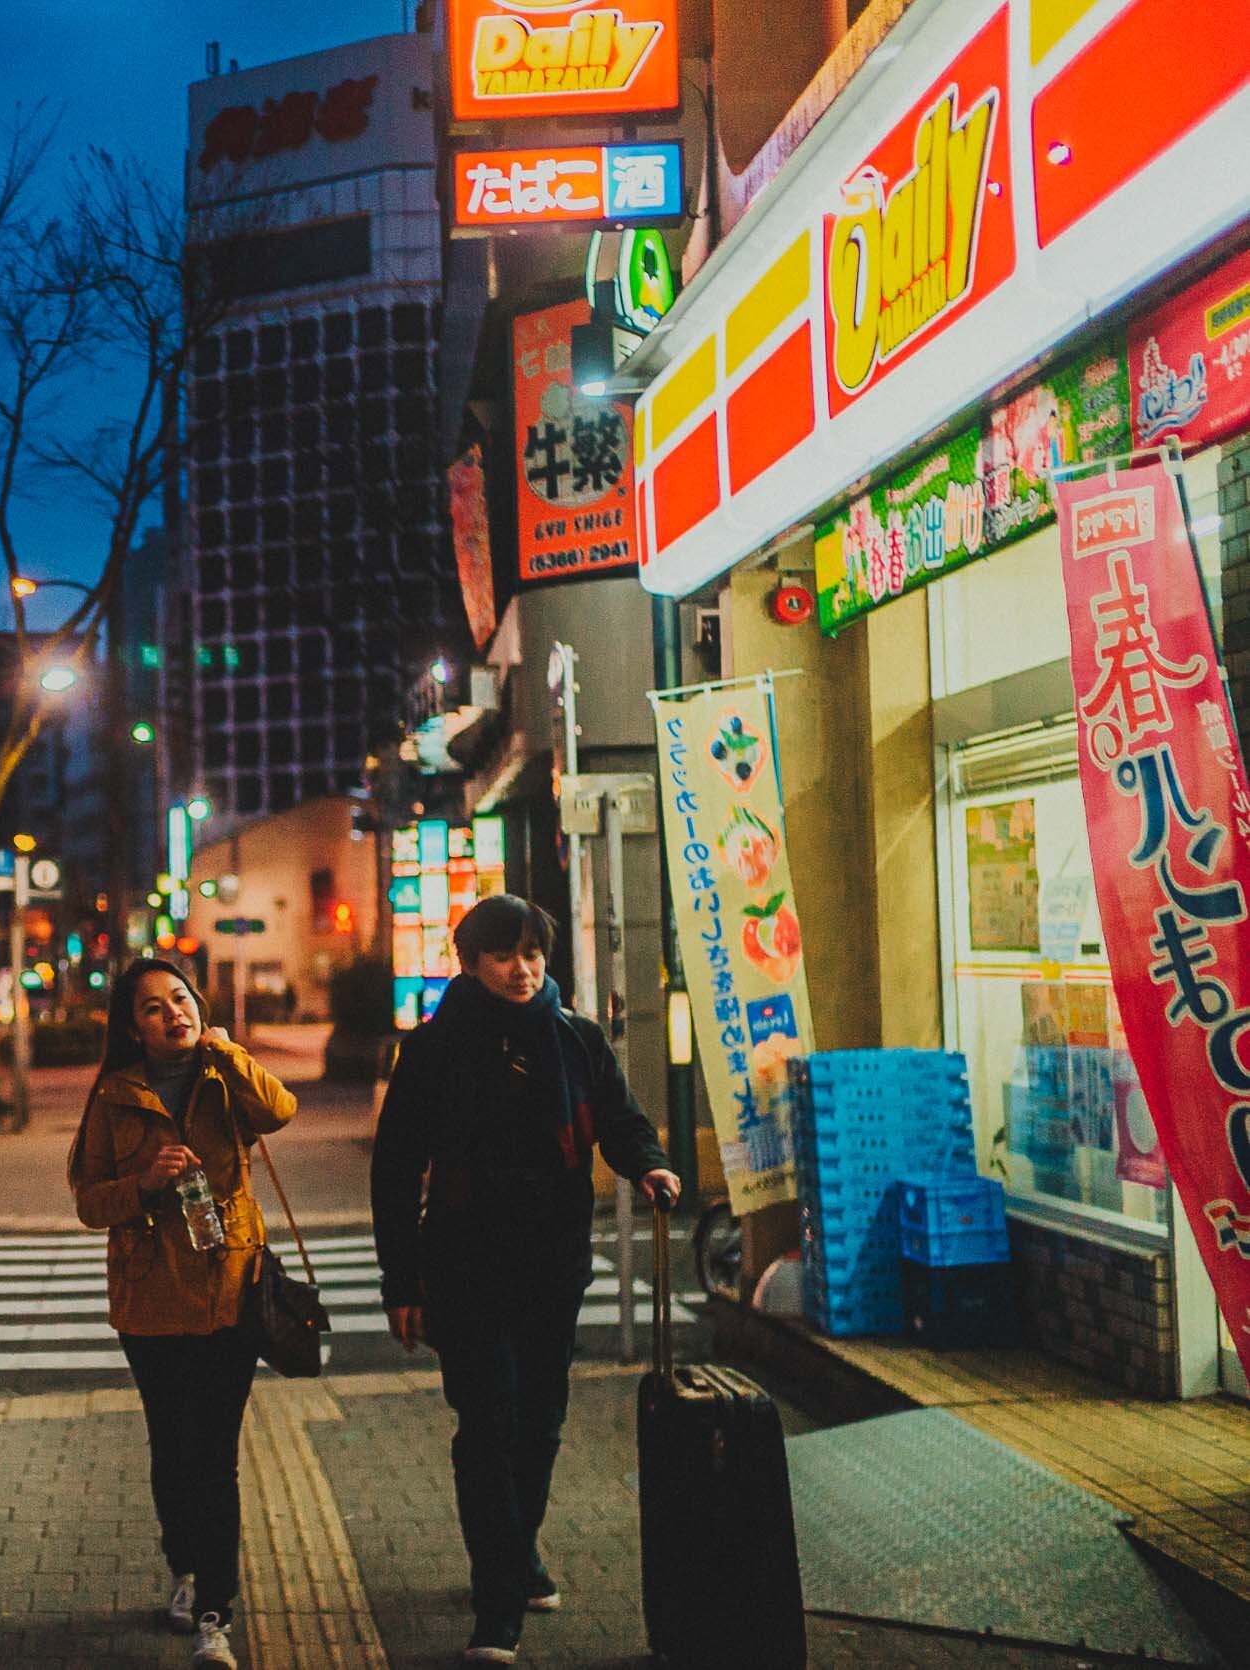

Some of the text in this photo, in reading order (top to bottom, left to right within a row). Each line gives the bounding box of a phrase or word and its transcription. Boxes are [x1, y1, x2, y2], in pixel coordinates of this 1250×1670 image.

[475, 13, 660, 89] Daily
[476, 65, 607, 96] YAMAZAKI
[466, 154, 666, 214] たばこ 酒
[829, 95, 995, 388] Daily
[524, 414, 624, 500] 牛繁
[534, 508, 624, 541] GYU SHIGE
